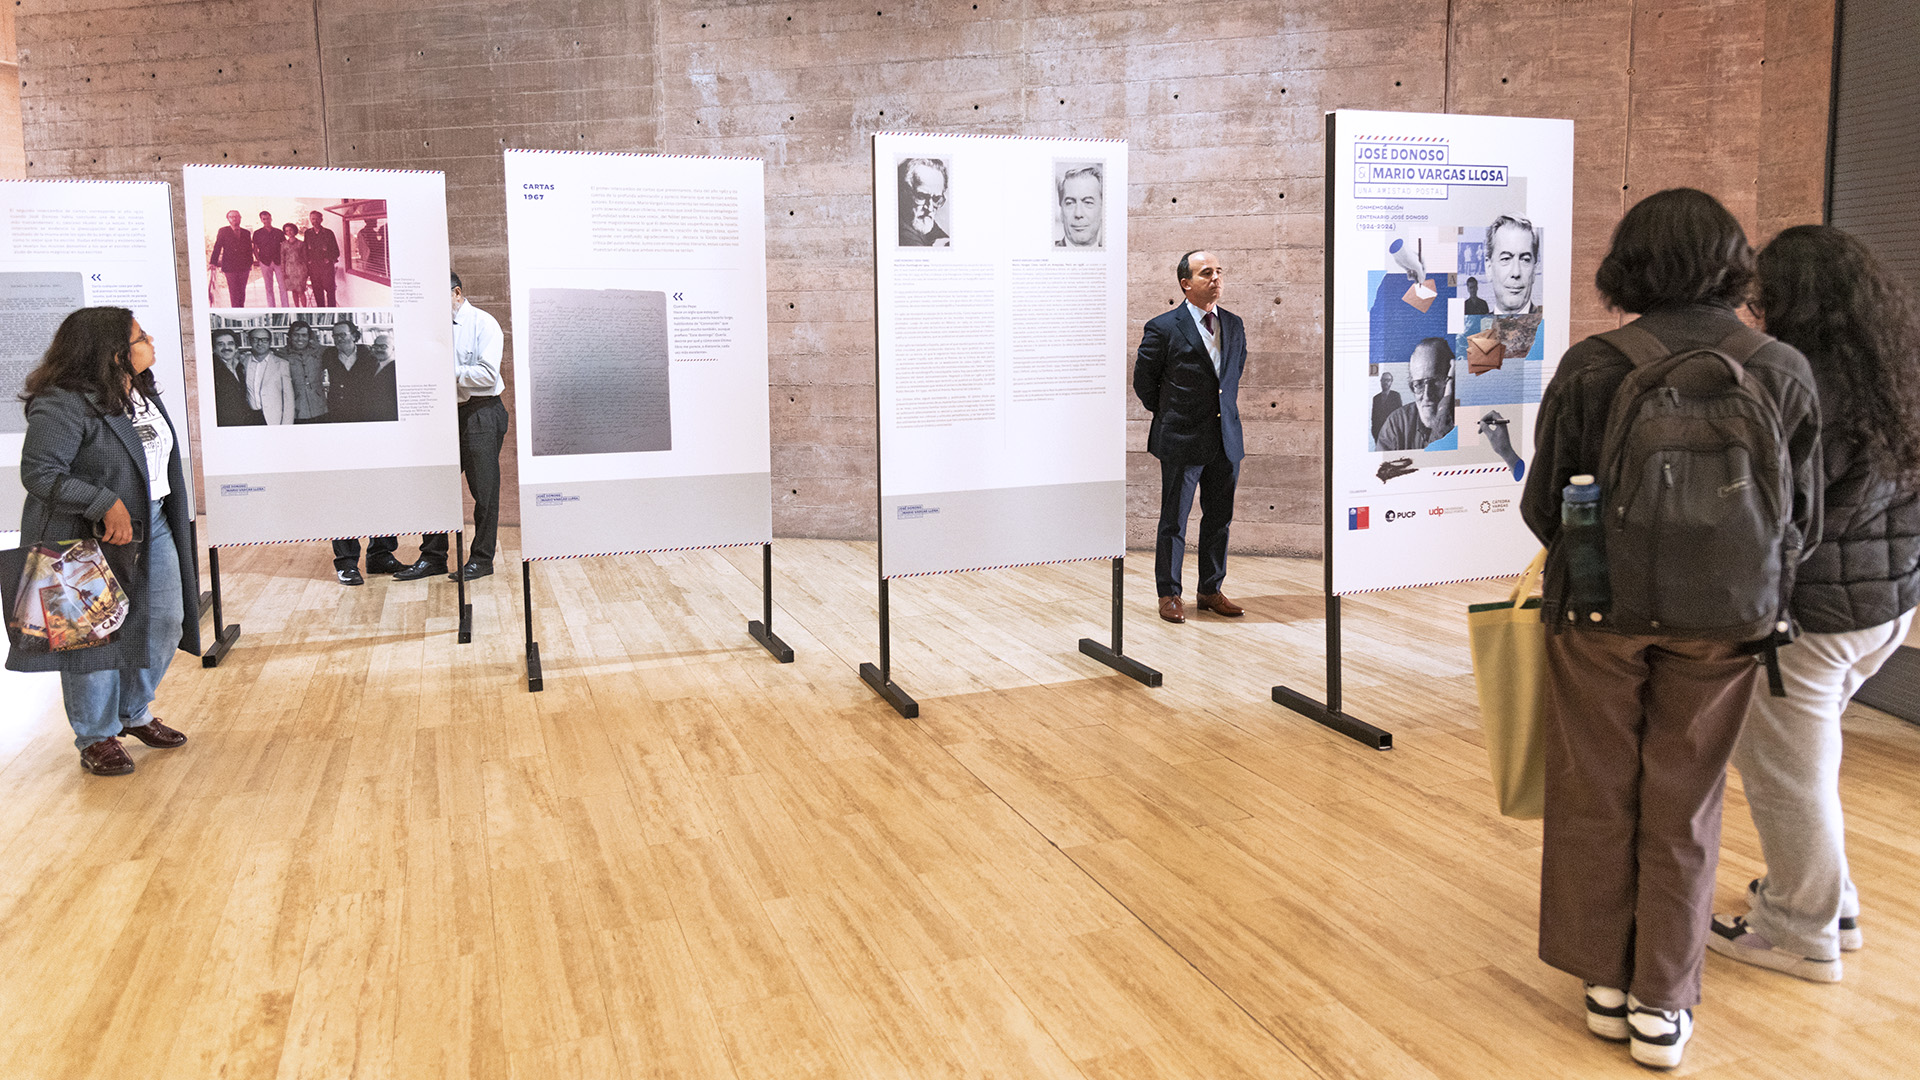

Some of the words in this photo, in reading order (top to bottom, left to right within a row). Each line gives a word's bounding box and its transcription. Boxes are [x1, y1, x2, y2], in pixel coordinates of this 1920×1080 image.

[1358, 143, 1388, 160] JOSÉ
[1391, 148, 1445, 161] DONOSO
[1358, 166, 1366, 179] &
[1373, 167, 1416, 179] MARIO
[1418, 168, 1466, 181] VARGAS
[1468, 169, 1504, 182] LLOSA
[1377, 187, 1411, 195] AMISTAD
[1416, 188, 1444, 196] POSTAL
[1356, 223, 1396, 231] (1924-2024)
[1397, 511, 1416, 519] PUCP
[1428, 506, 1444, 517] udp
